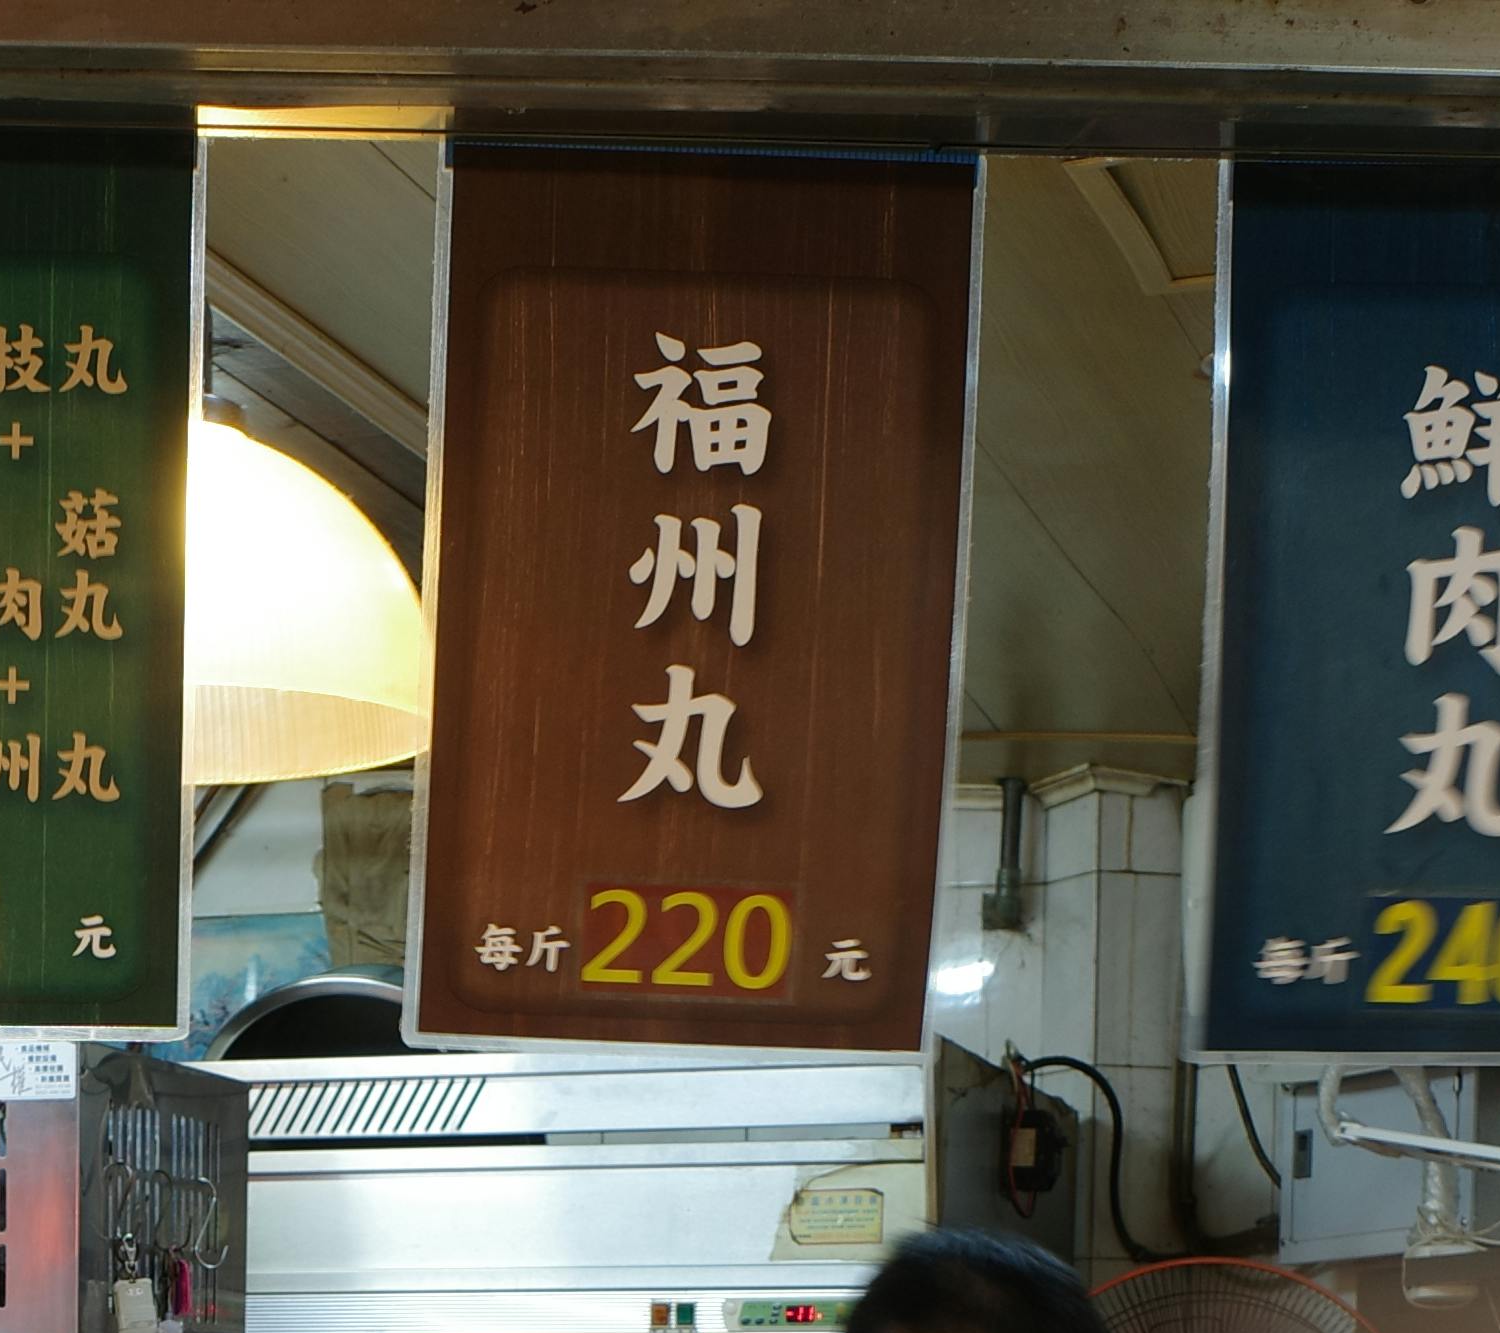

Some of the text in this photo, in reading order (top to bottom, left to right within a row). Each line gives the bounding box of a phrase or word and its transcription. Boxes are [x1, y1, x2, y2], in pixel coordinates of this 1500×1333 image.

[616, 331, 772, 809] 福州丸
[73, 915, 117, 960] 元
[474, 888, 872, 991] 每斤 220 元
[1252, 936, 1361, 985] 每斤
